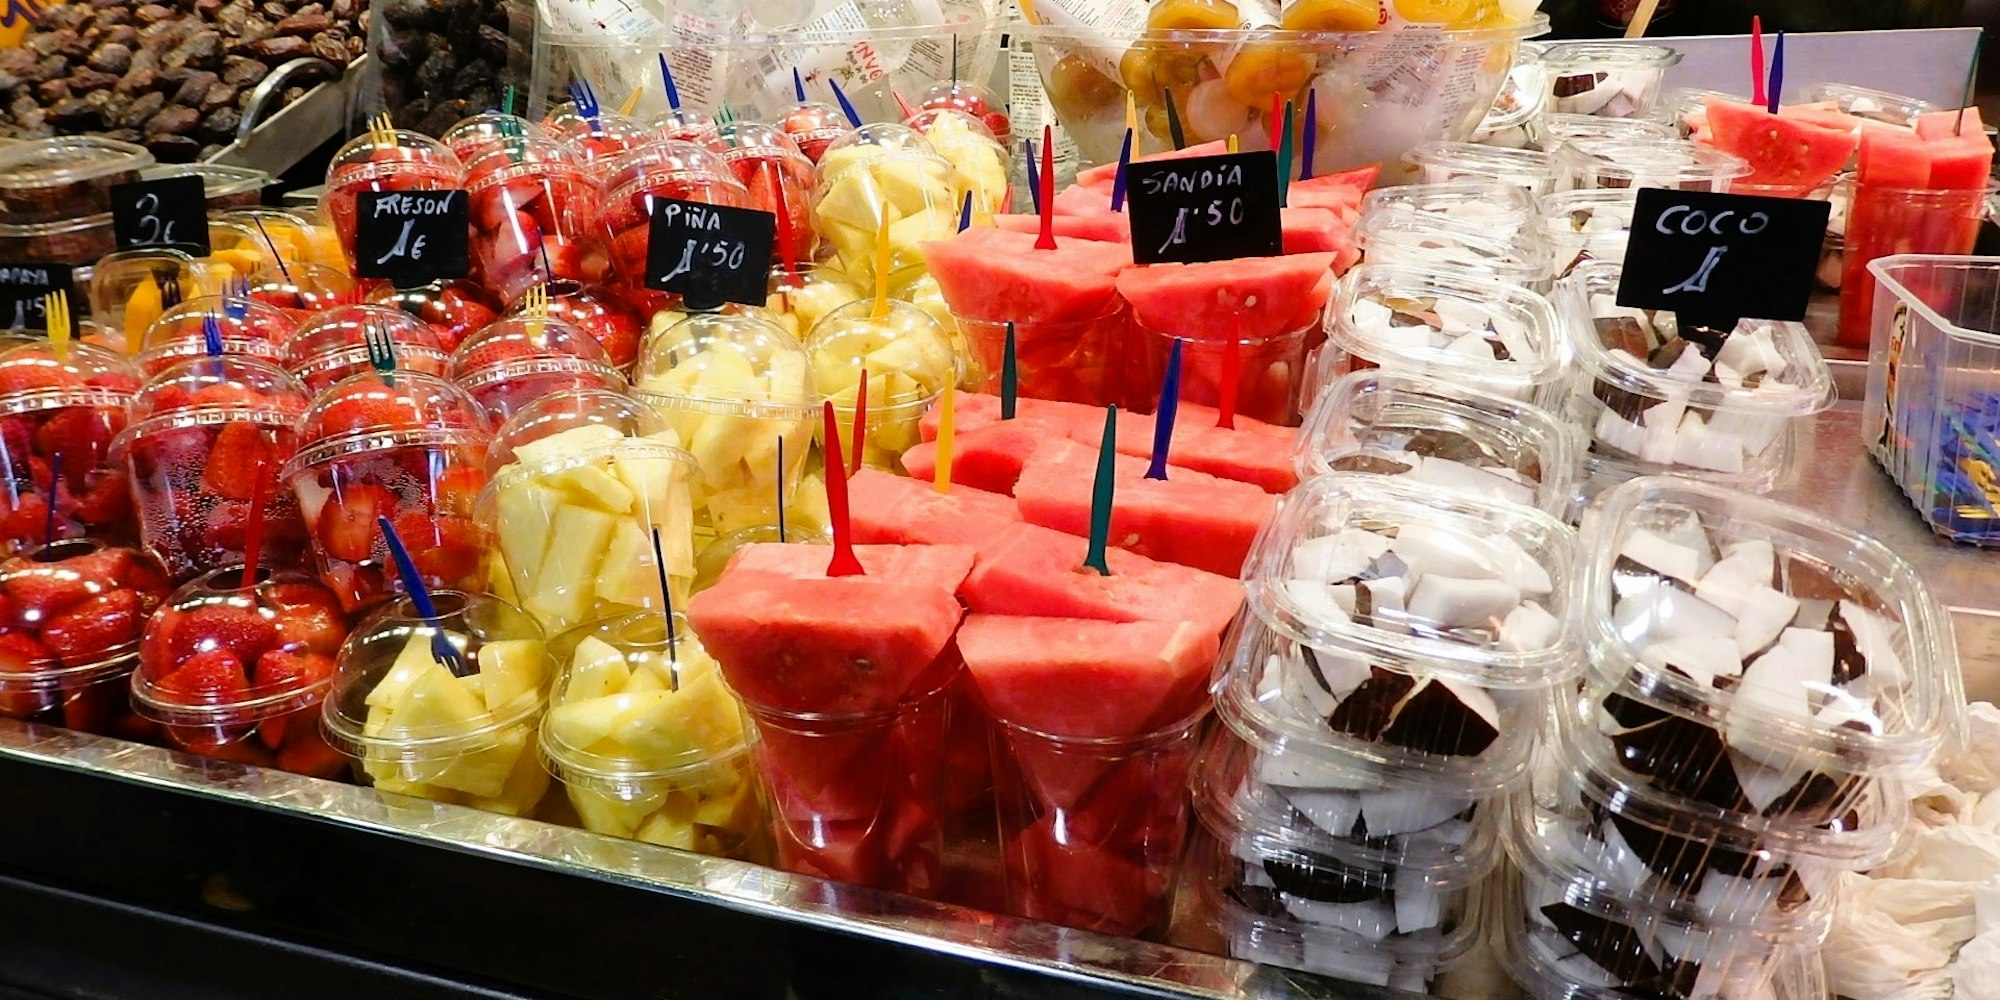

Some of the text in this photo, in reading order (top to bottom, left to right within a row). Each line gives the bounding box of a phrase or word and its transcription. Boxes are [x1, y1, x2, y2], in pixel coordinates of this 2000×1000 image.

[373, 189, 457, 219] FRESON
[664, 203, 721, 231] PIÑA
[1655, 204, 1769, 235] COCO
[1662, 245, 1729, 295] 1
